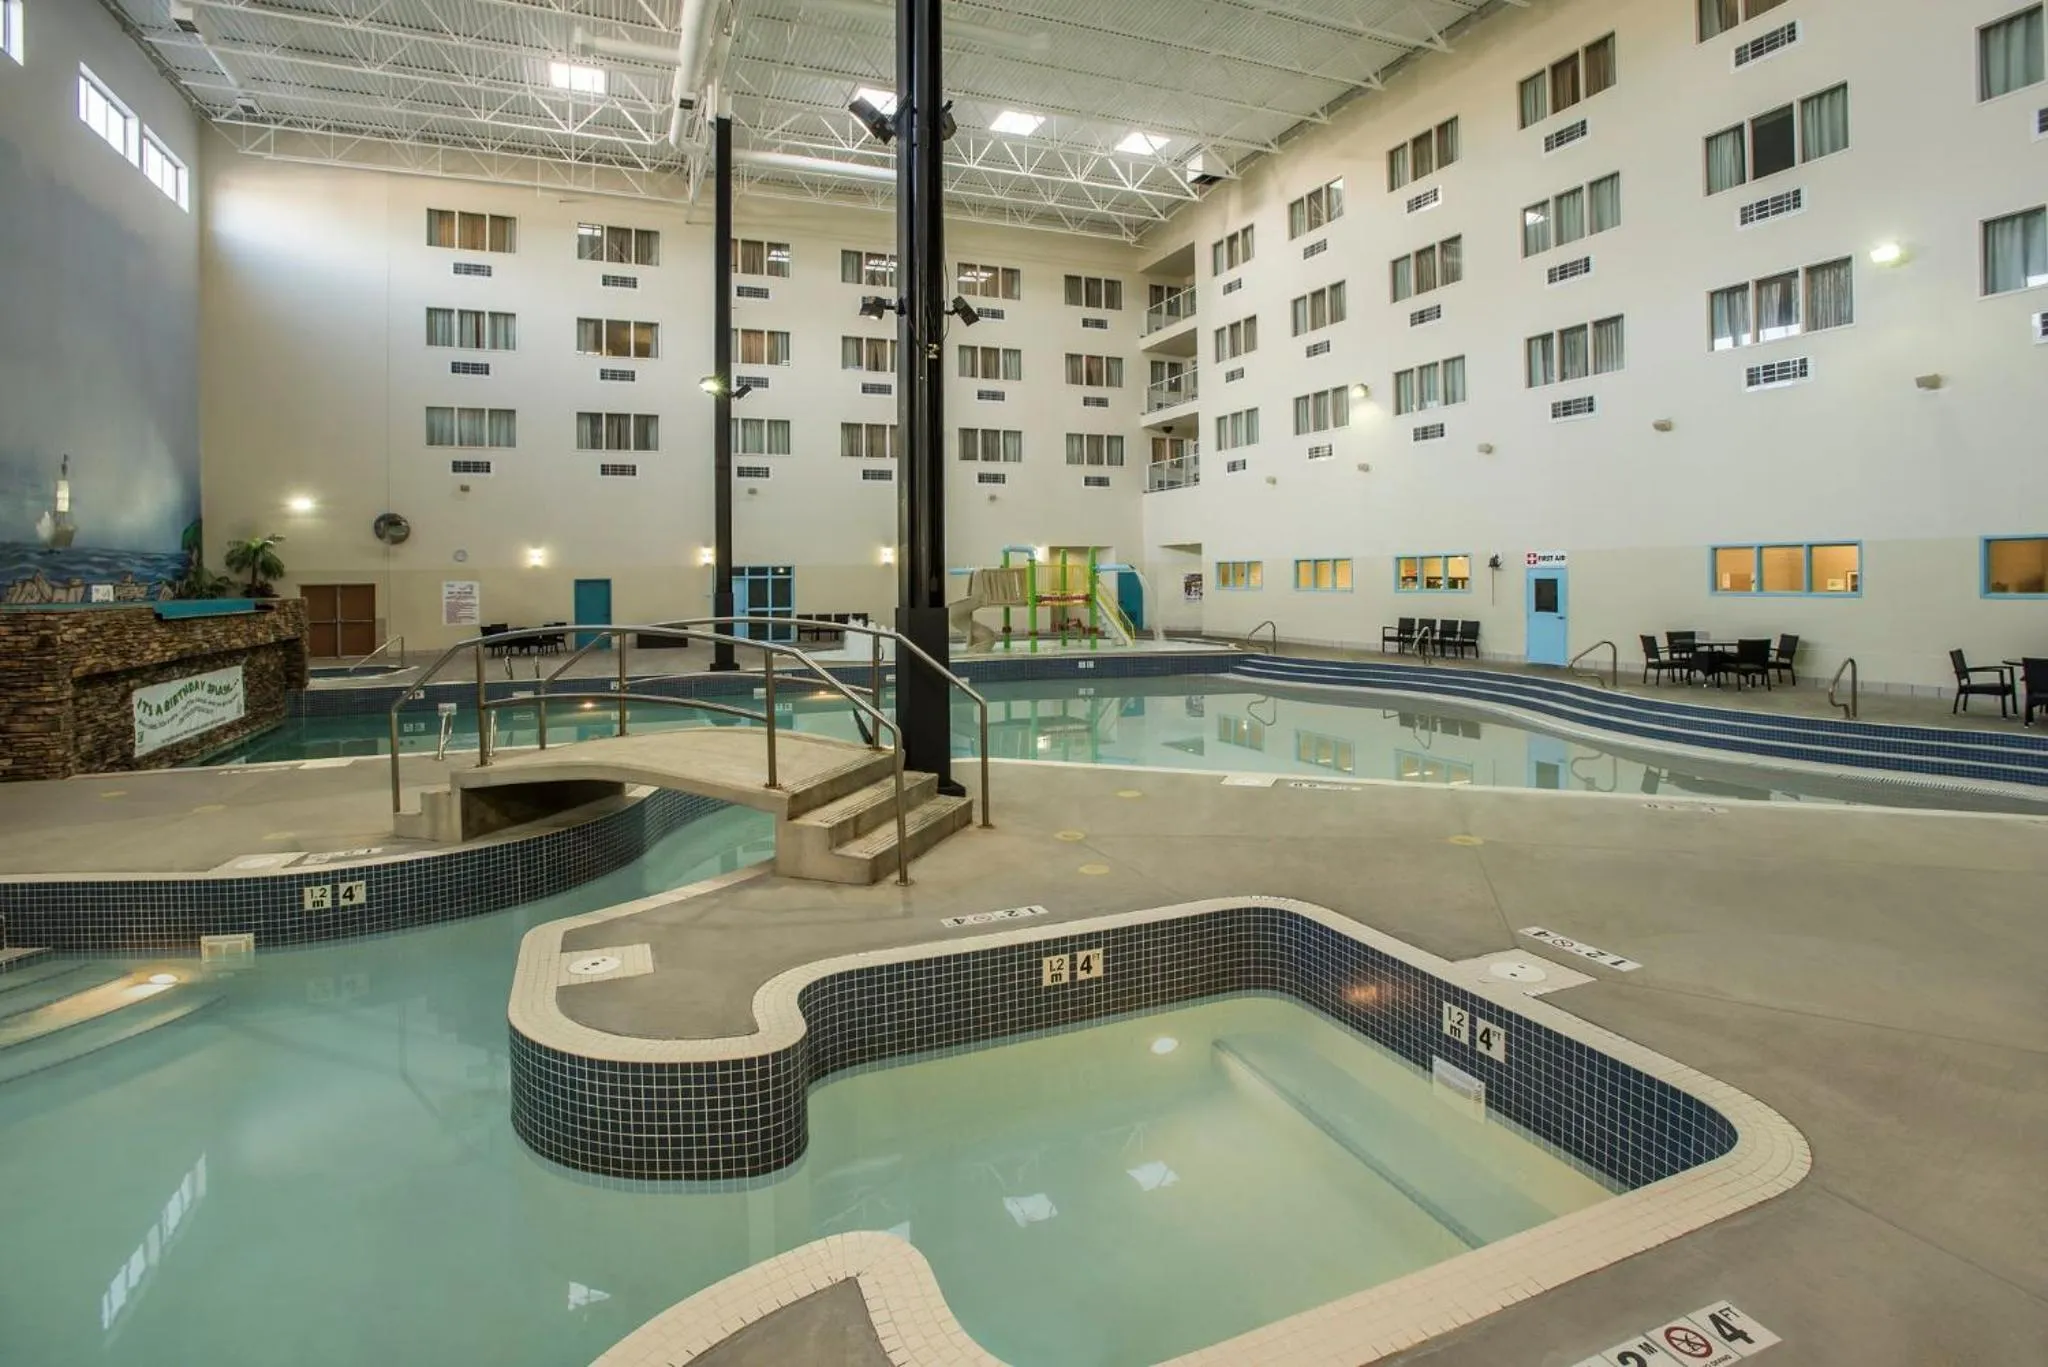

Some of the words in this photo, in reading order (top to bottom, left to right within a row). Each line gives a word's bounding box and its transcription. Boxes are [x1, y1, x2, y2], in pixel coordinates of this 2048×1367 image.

[155, 703, 164, 717] A
[164, 679, 206, 713] BIRTHDAY
[1708, 1313, 1756, 1344] 4
